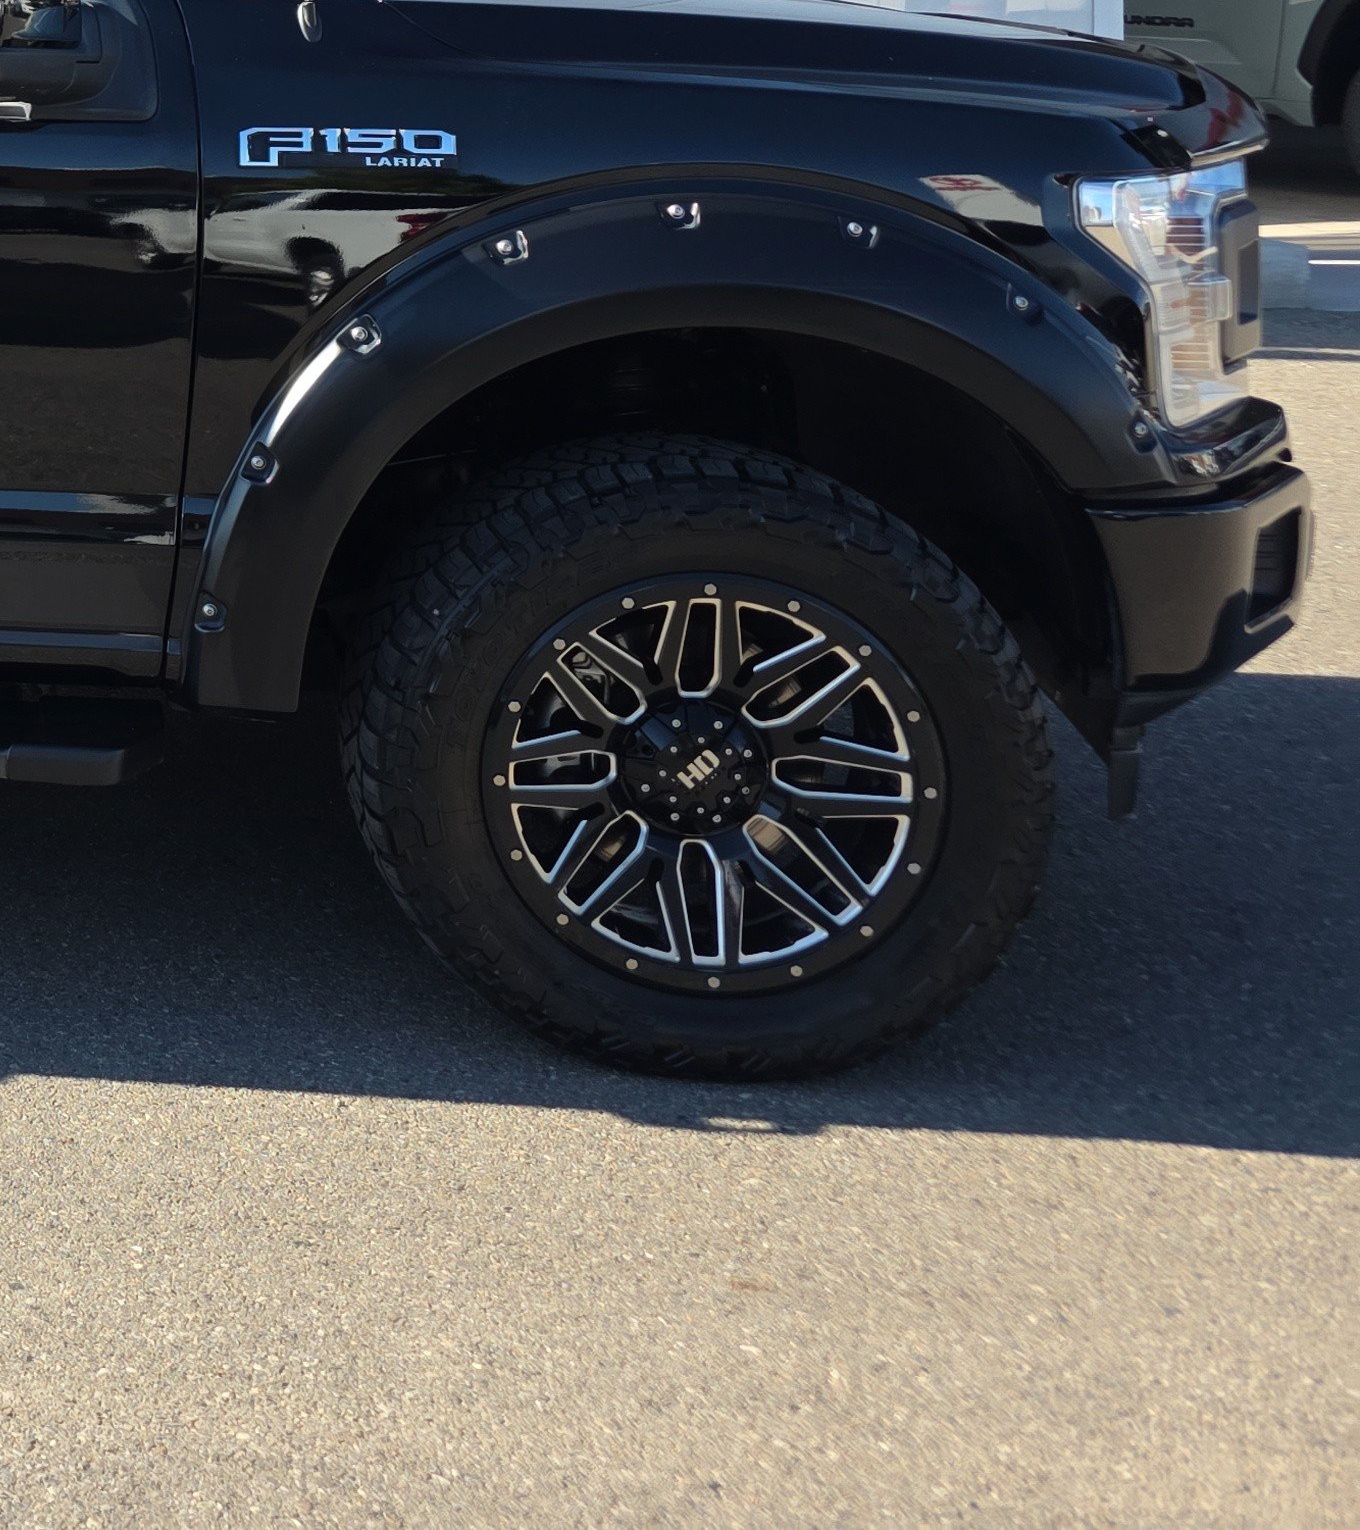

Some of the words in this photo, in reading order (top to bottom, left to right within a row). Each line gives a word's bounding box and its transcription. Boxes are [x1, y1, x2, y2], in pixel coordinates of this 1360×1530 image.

[1124, 14, 1194, 28] UNDRA
[365, 156, 445, 168] LARIAT
[676, 749, 721, 790] HD
